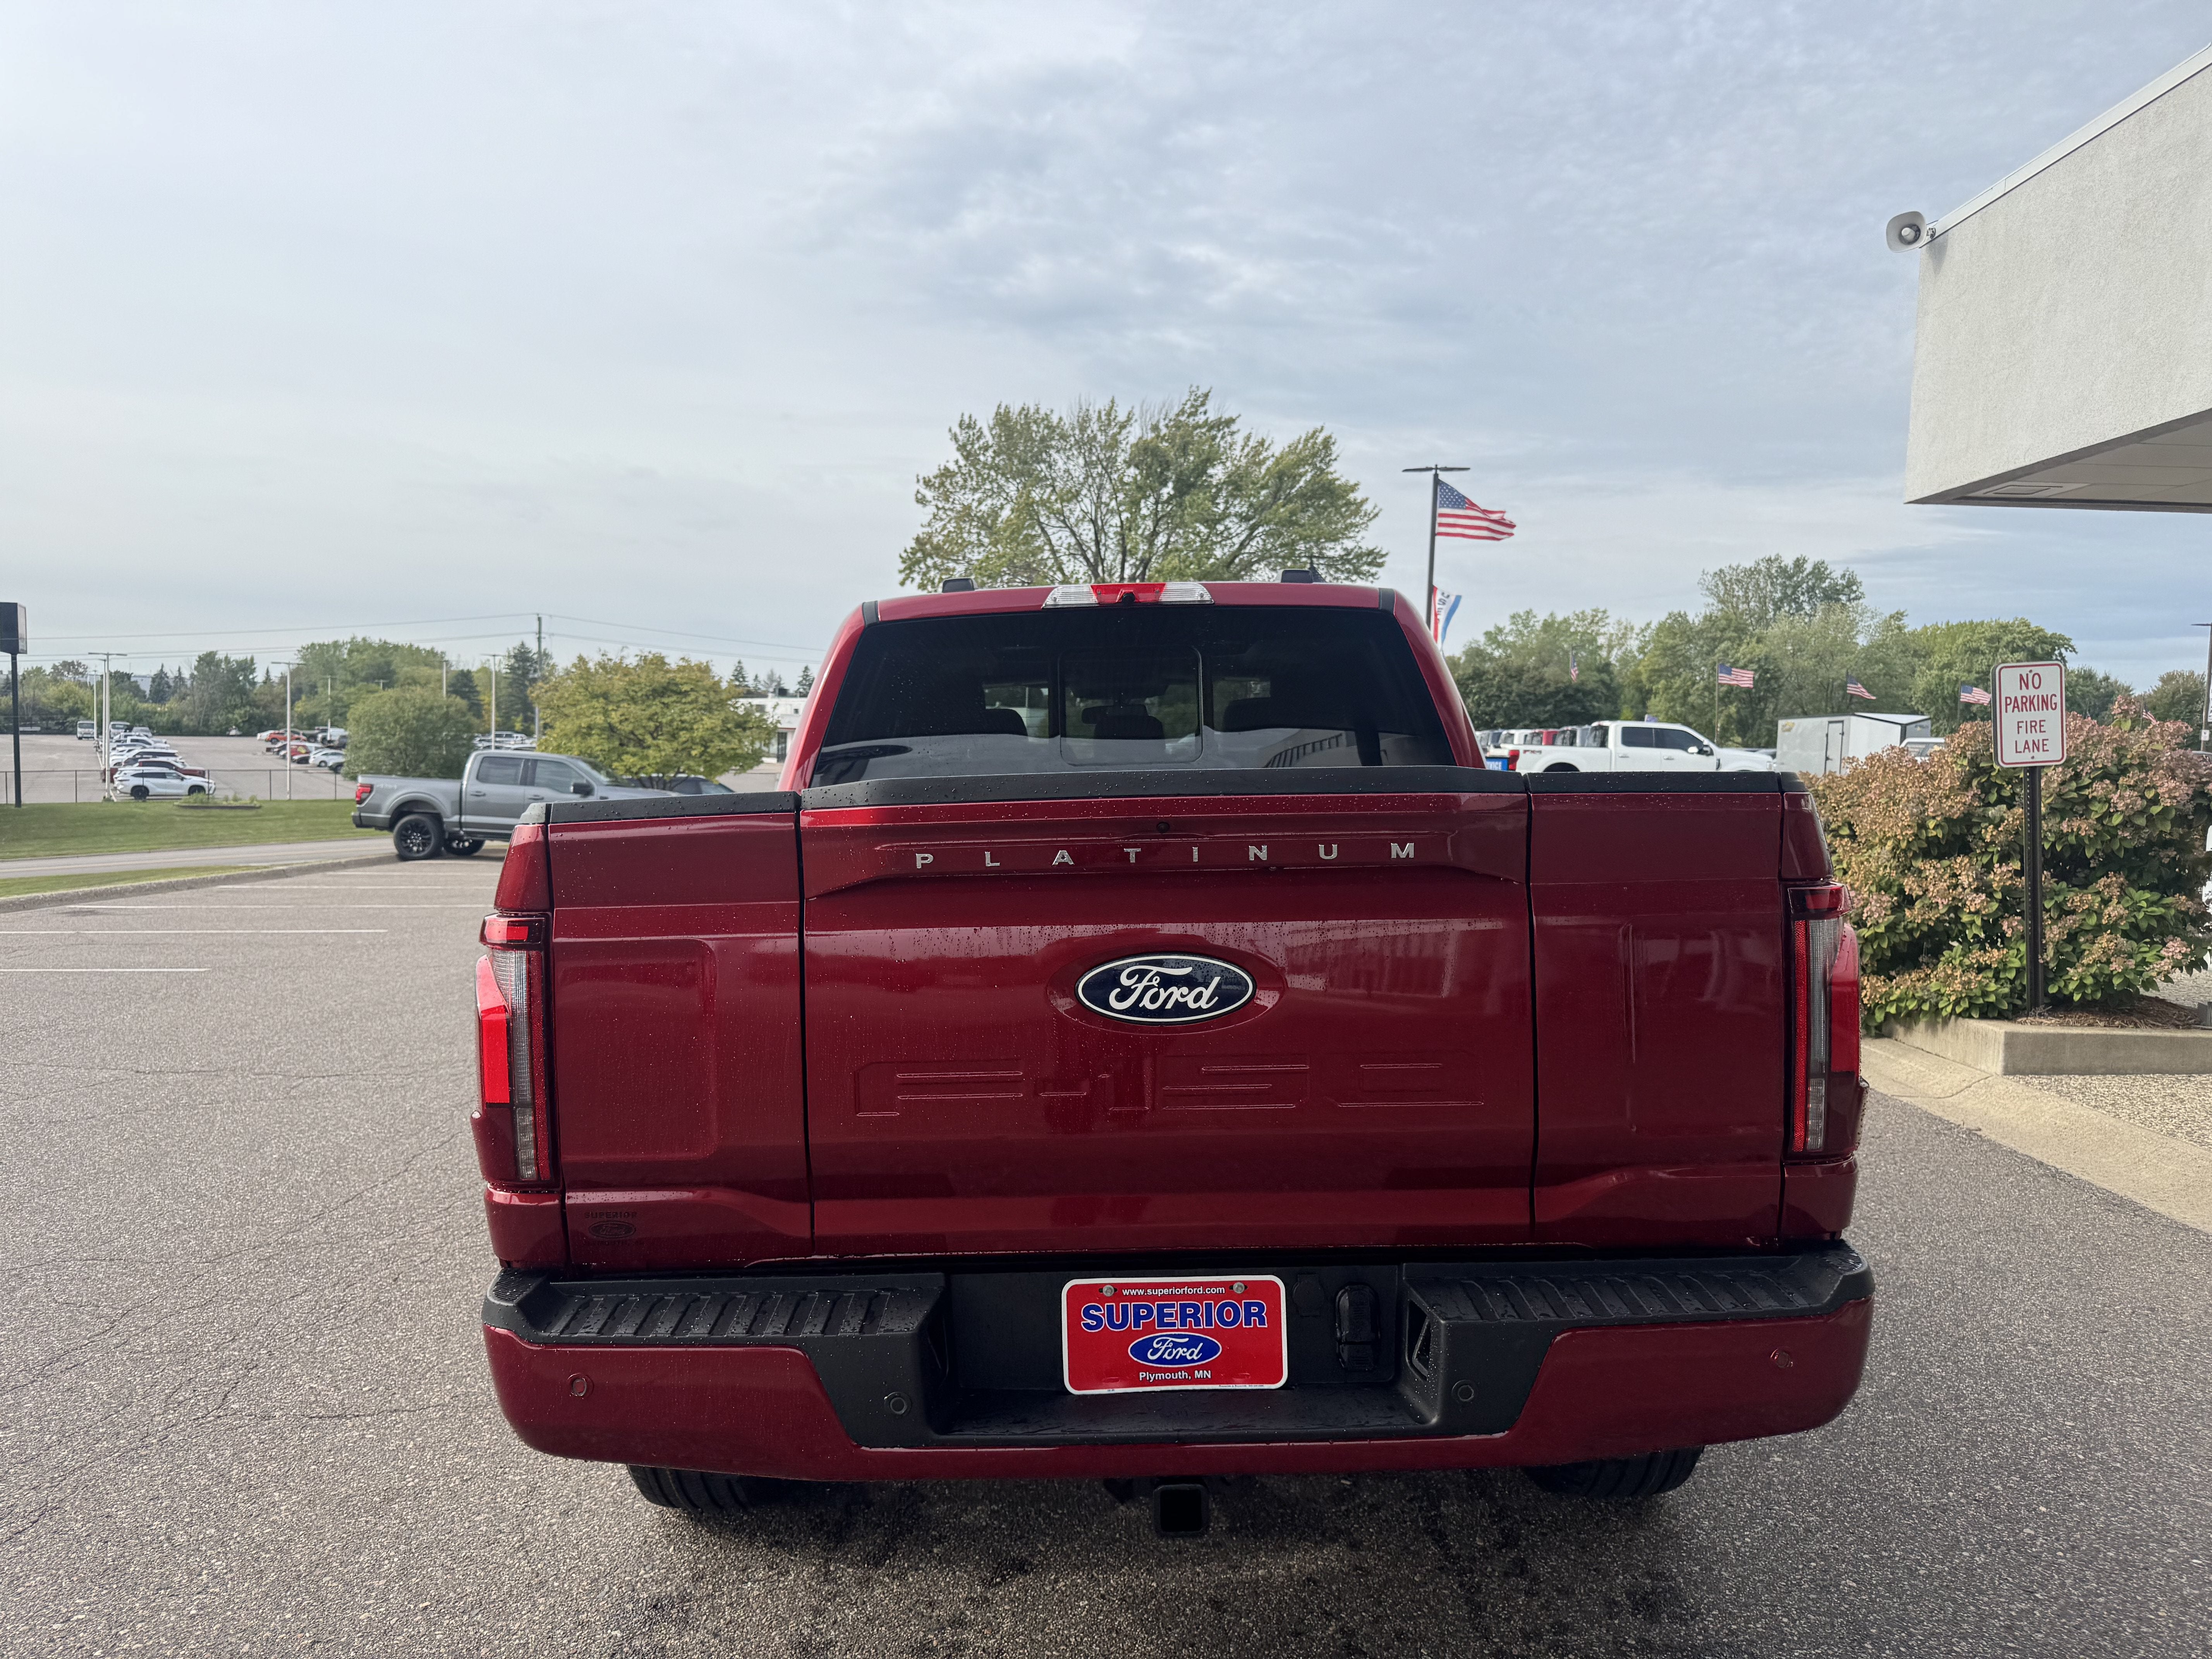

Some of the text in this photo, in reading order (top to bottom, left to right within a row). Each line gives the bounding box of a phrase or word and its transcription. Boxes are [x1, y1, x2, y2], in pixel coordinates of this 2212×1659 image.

[2020, 672, 2042, 690] NO
[2005, 694, 2057, 713] PARKING
[2017, 720, 2046, 734] FIRE
[2015, 738, 2049, 754] LANE
[915, 842, 1415, 869] PLATINUM
[1109, 965, 1221, 1010] Ford
[1122, 1286, 1225, 1297] www.superiorford.com
[1081, 1300, 1267, 1332] SUPERIOR
[1147, 1337, 1203, 1360] Ford
[1139, 1370, 1211, 1382] Plymouth, MN
